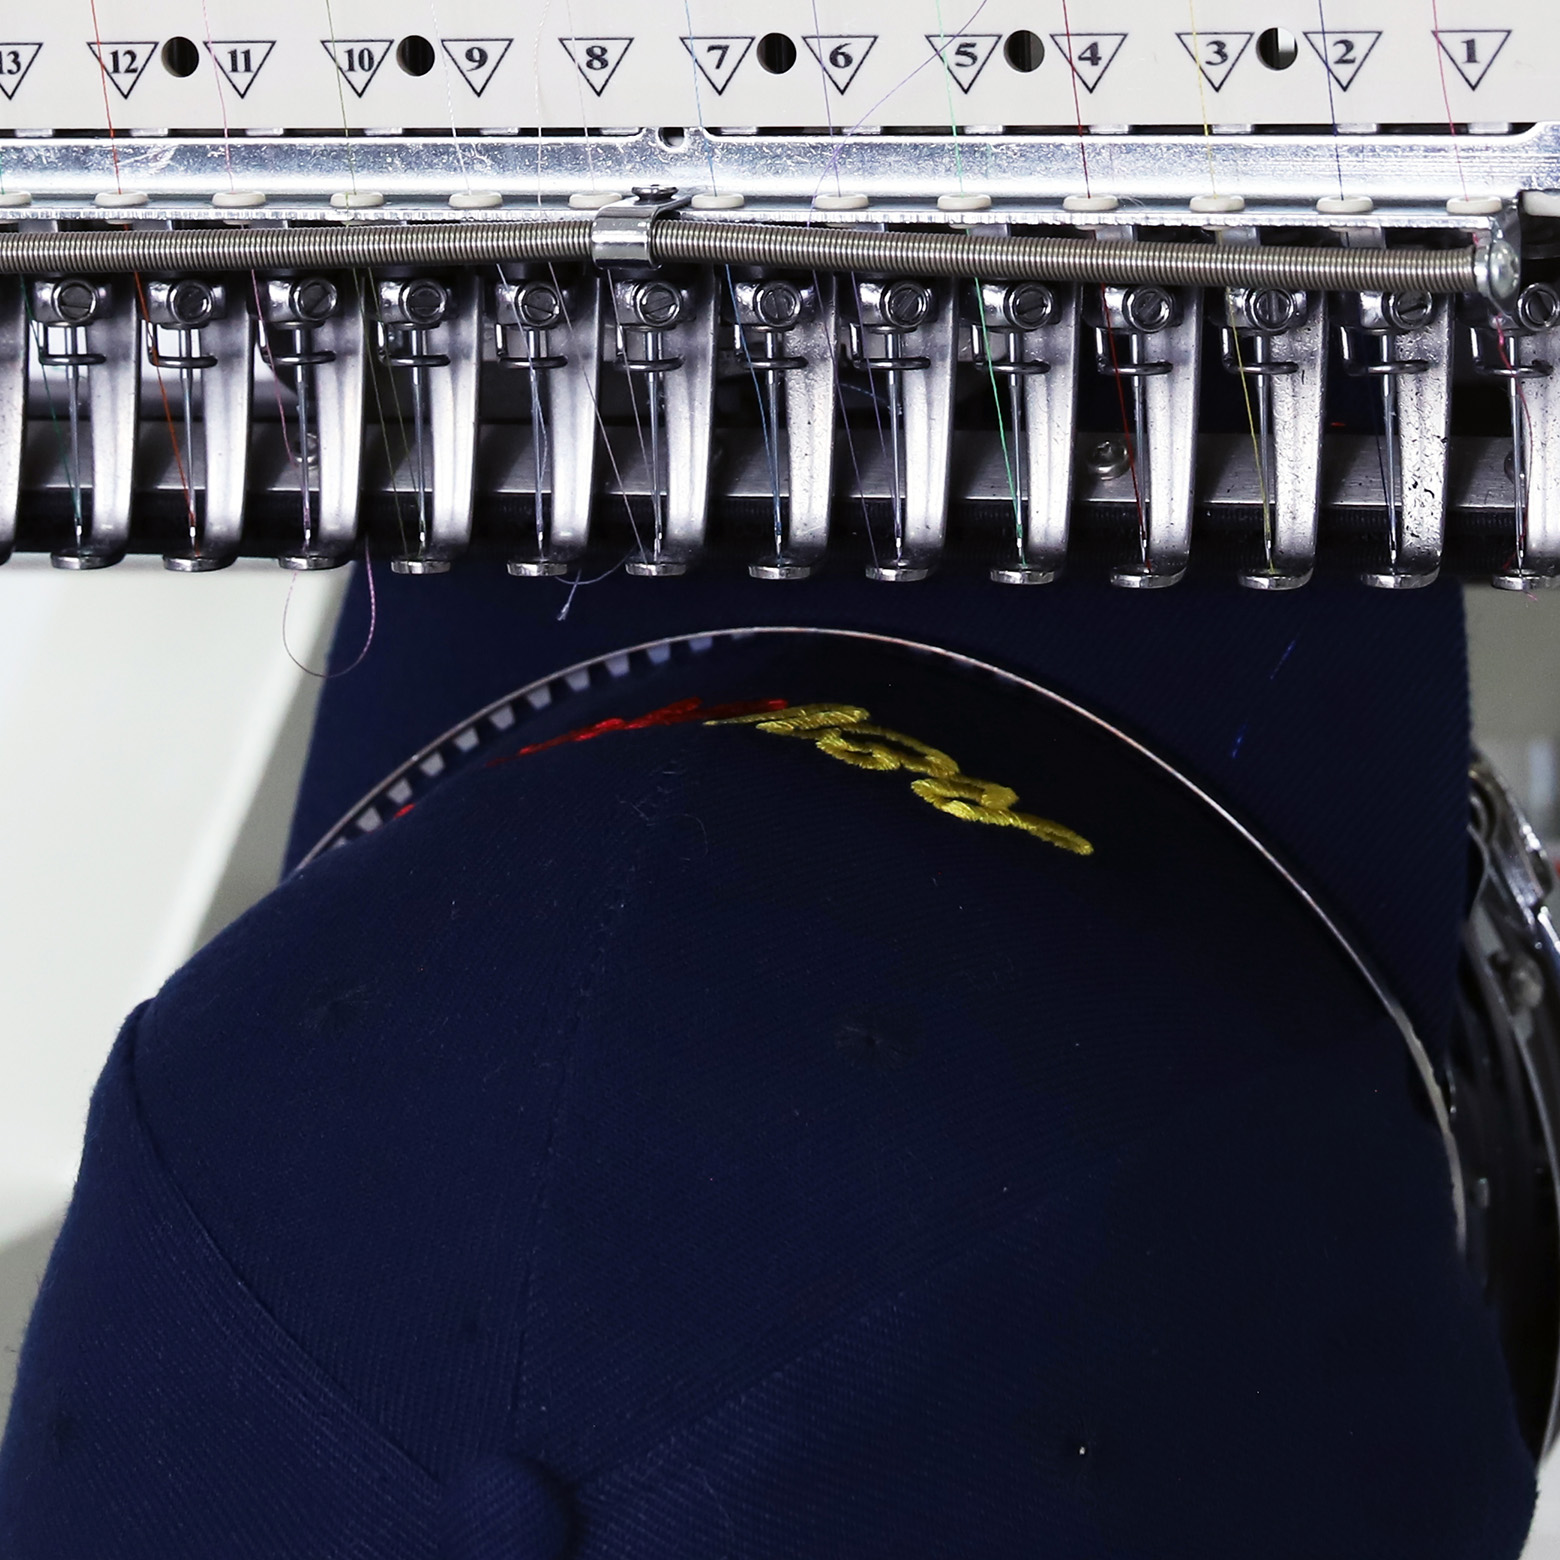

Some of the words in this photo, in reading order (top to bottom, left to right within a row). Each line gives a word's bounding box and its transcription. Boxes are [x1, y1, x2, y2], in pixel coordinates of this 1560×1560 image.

[110, 50, 139, 74] 12
[227, 49, 253, 73] 11
[345, 48, 375, 72] 10
[466, 47, 489, 71] 9
[586, 46, 609, 70] 8
[707, 45, 730, 69] 7
[830, 43, 854, 68] 6
[954, 42, 978, 67] 5
[1077, 42, 1102, 66] 4
[1205, 41, 1229, 65] 3
[1333, 40, 1356, 64] 2
[1463, 39, 1478, 63] 1
